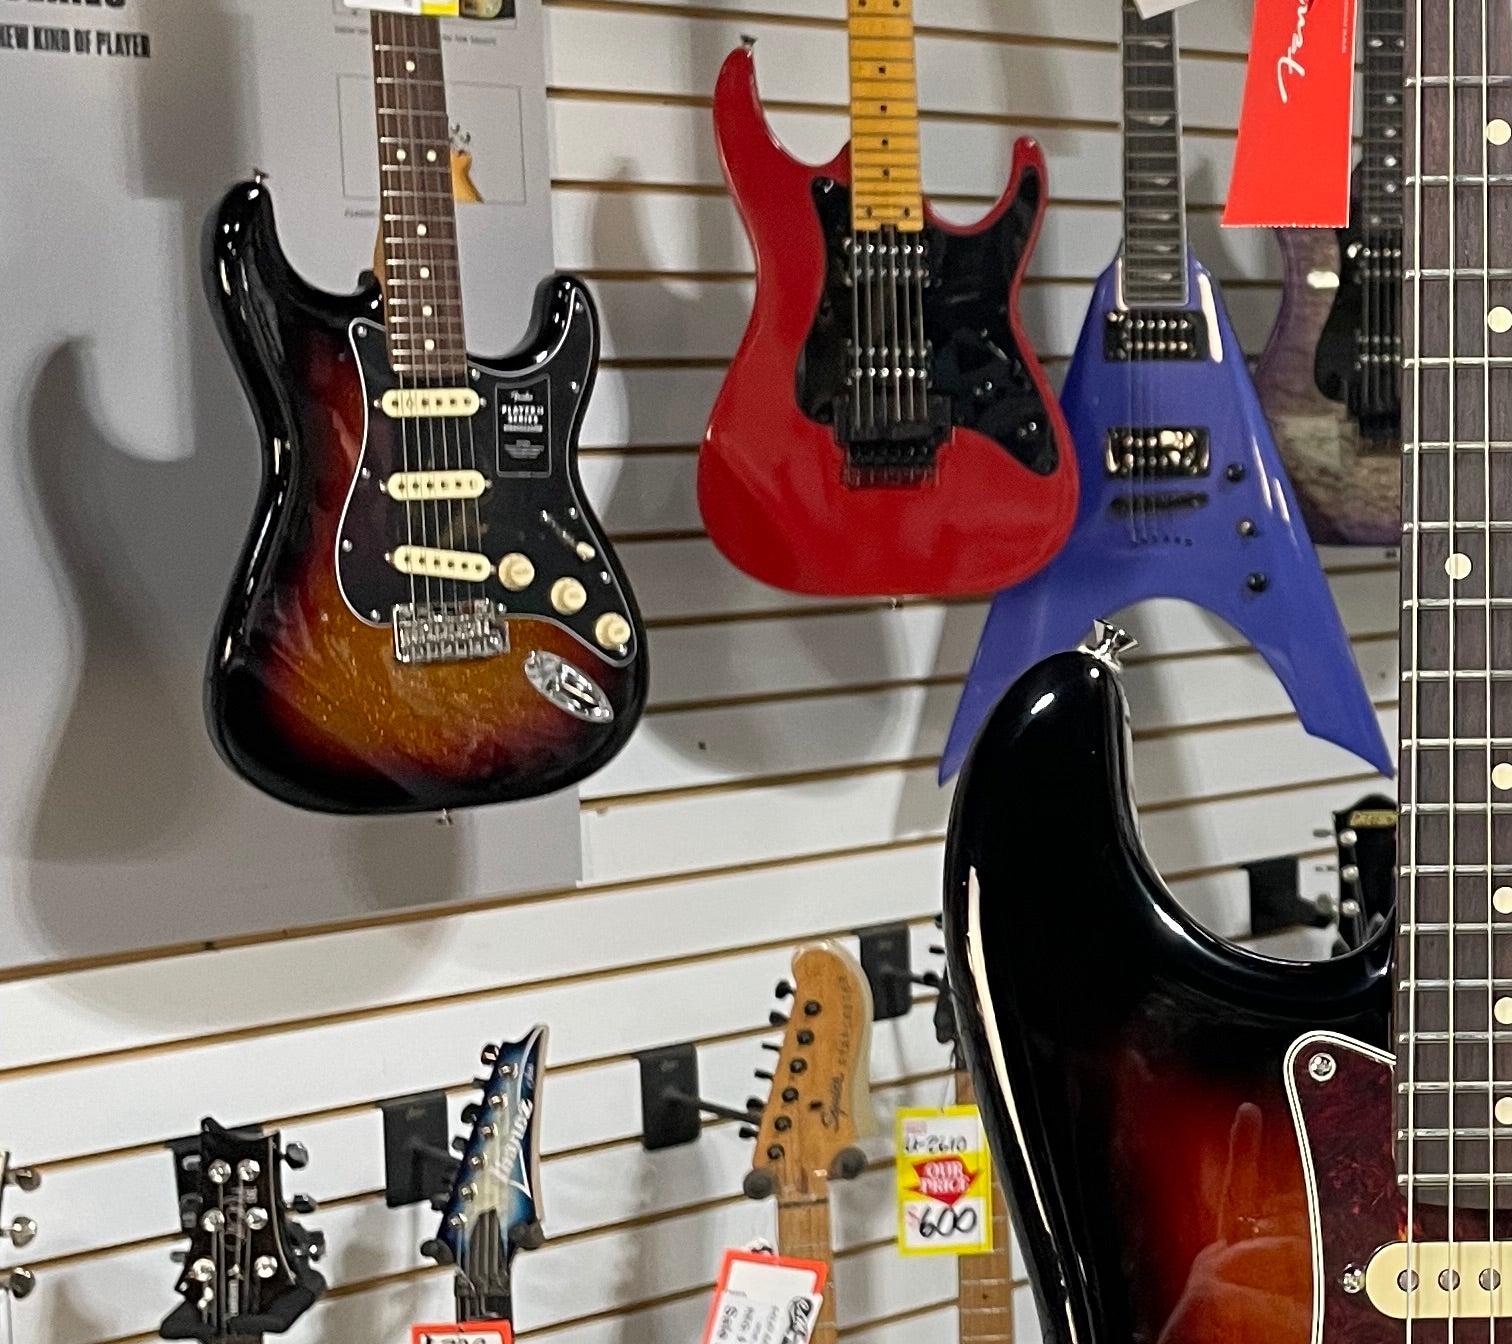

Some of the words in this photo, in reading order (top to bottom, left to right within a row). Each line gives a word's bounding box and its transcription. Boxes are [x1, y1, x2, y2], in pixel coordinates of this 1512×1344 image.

[33, 25, 71, 54] KIND
[74, 28, 91, 55] OF
[96, 29, 152, 59] PLAYER
[923, 1160, 964, 1178] OUR
[919, 1175, 972, 1194] PRICE
